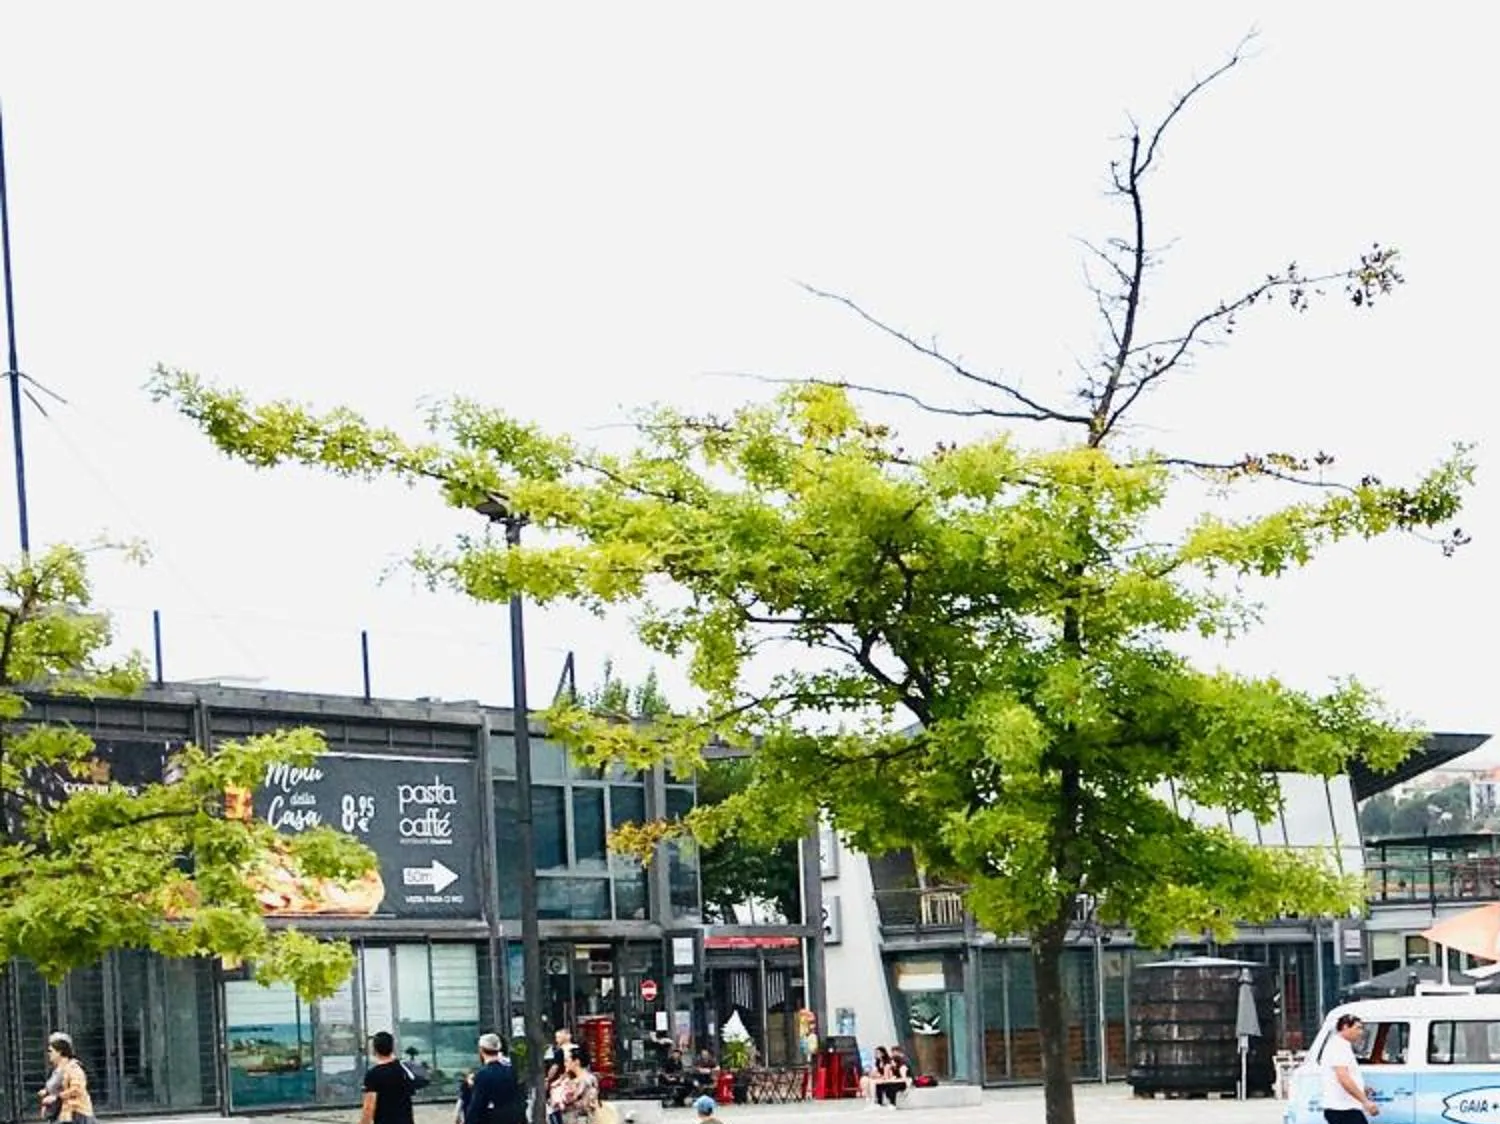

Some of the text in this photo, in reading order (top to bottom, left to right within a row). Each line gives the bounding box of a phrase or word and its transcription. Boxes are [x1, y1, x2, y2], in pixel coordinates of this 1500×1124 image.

[265, 762, 323, 792] Menu
[397, 775, 457, 815] pasta
[268, 795, 322, 831] Casa
[1460, 1099, 1489, 1113] GAIA
